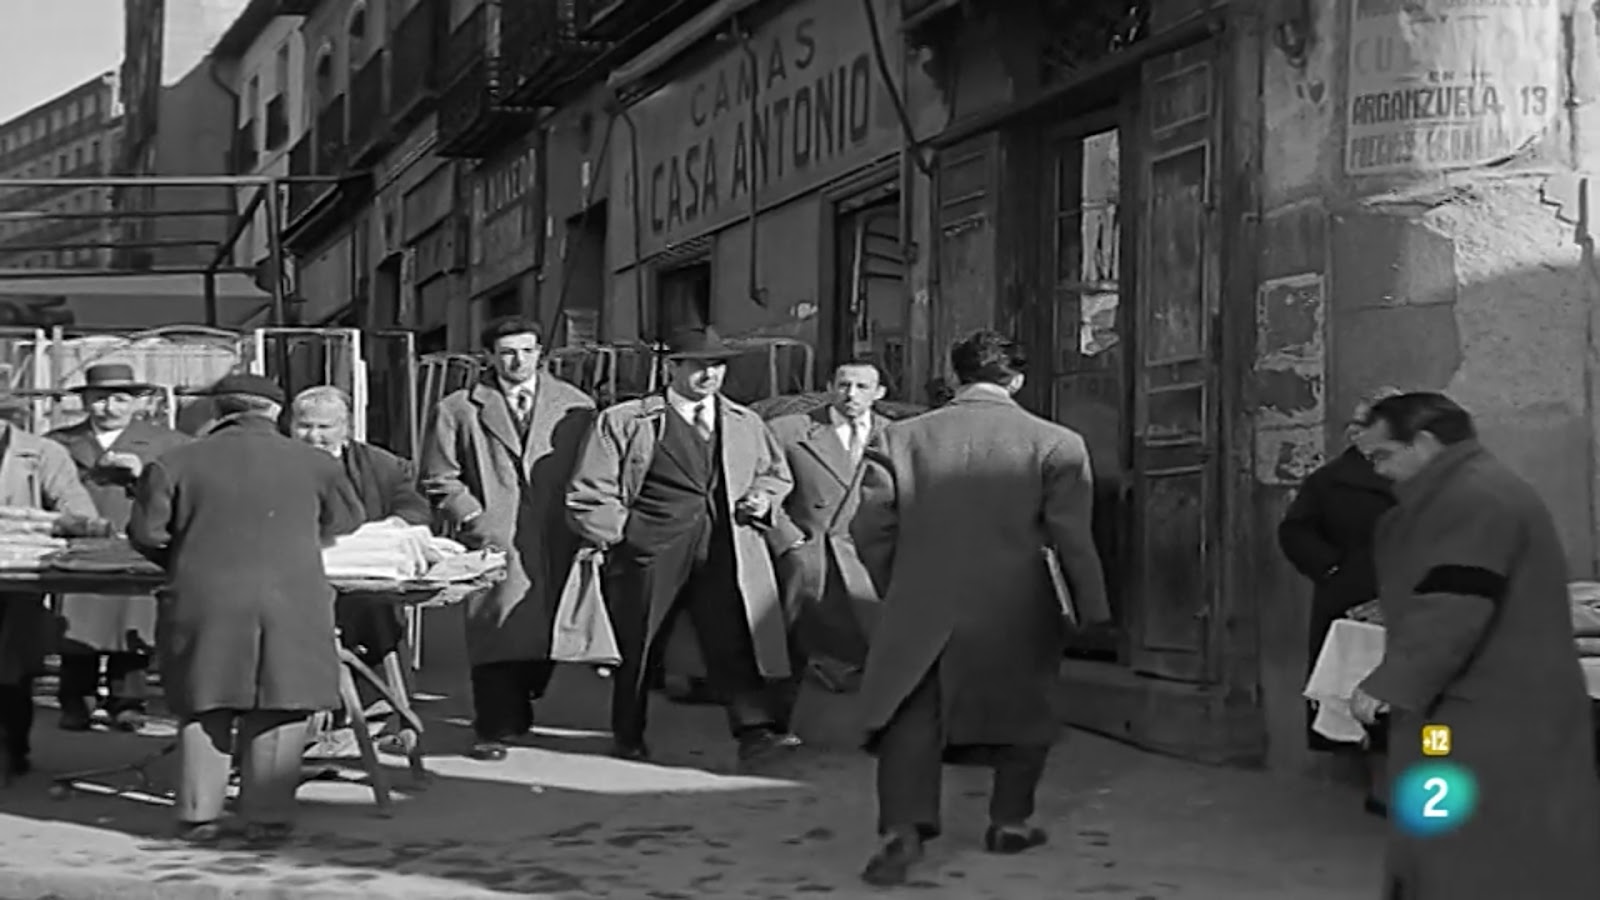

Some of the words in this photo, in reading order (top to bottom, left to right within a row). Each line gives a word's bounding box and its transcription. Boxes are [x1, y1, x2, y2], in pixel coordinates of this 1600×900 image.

[651, 136, 718, 234] CASA
[731, 53, 870, 200] ANTONIO
[1520, 85, 1548, 116] 13
